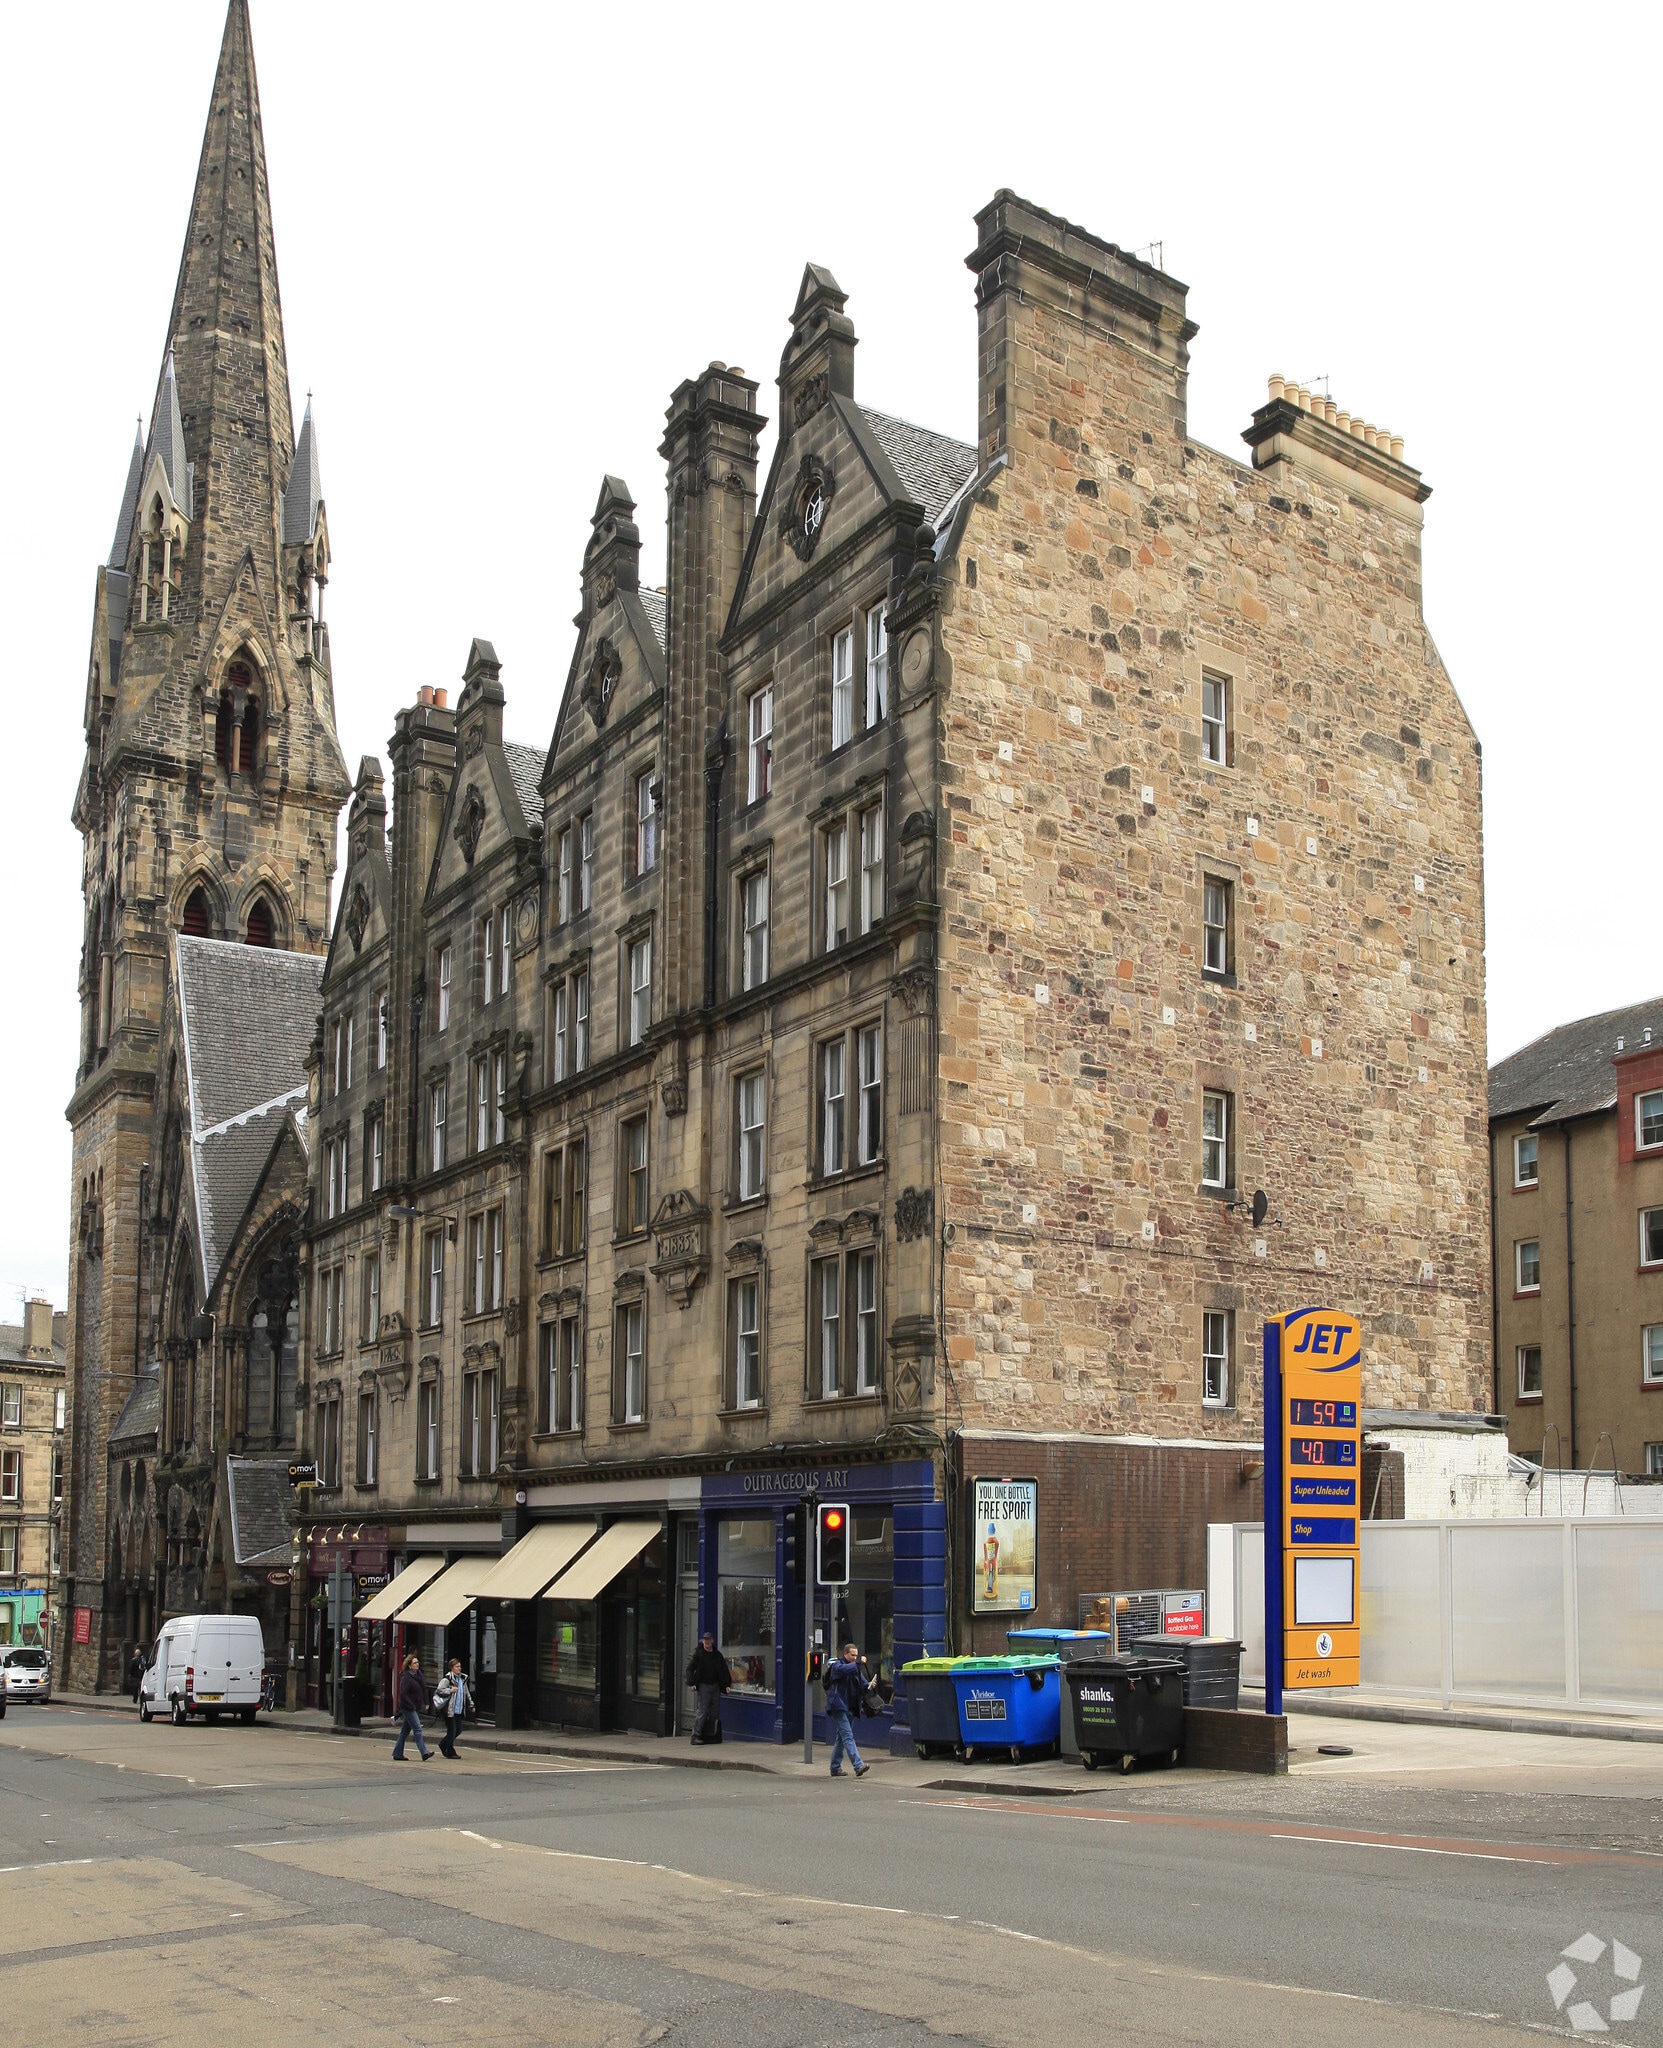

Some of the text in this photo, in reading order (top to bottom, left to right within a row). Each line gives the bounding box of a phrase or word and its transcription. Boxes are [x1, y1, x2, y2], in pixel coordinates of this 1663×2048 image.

[1293, 1322, 1353, 1355] JET
[743, 1470, 849, 1492] OUTRAGEOUS ART
[978, 1486, 1032, 1500] YOU. ONE BOTTLE.
[1294, 1484, 1351, 1497] Super Unleaded
[978, 1501, 1032, 1520] FREE SPORT
[1294, 1524, 1312, 1537] Shop
[1167, 1616, 1184, 1624] Bottled
[1296, 1667, 1331, 1679] Jet wash
[1080, 1686, 1114, 1702] shanks.
